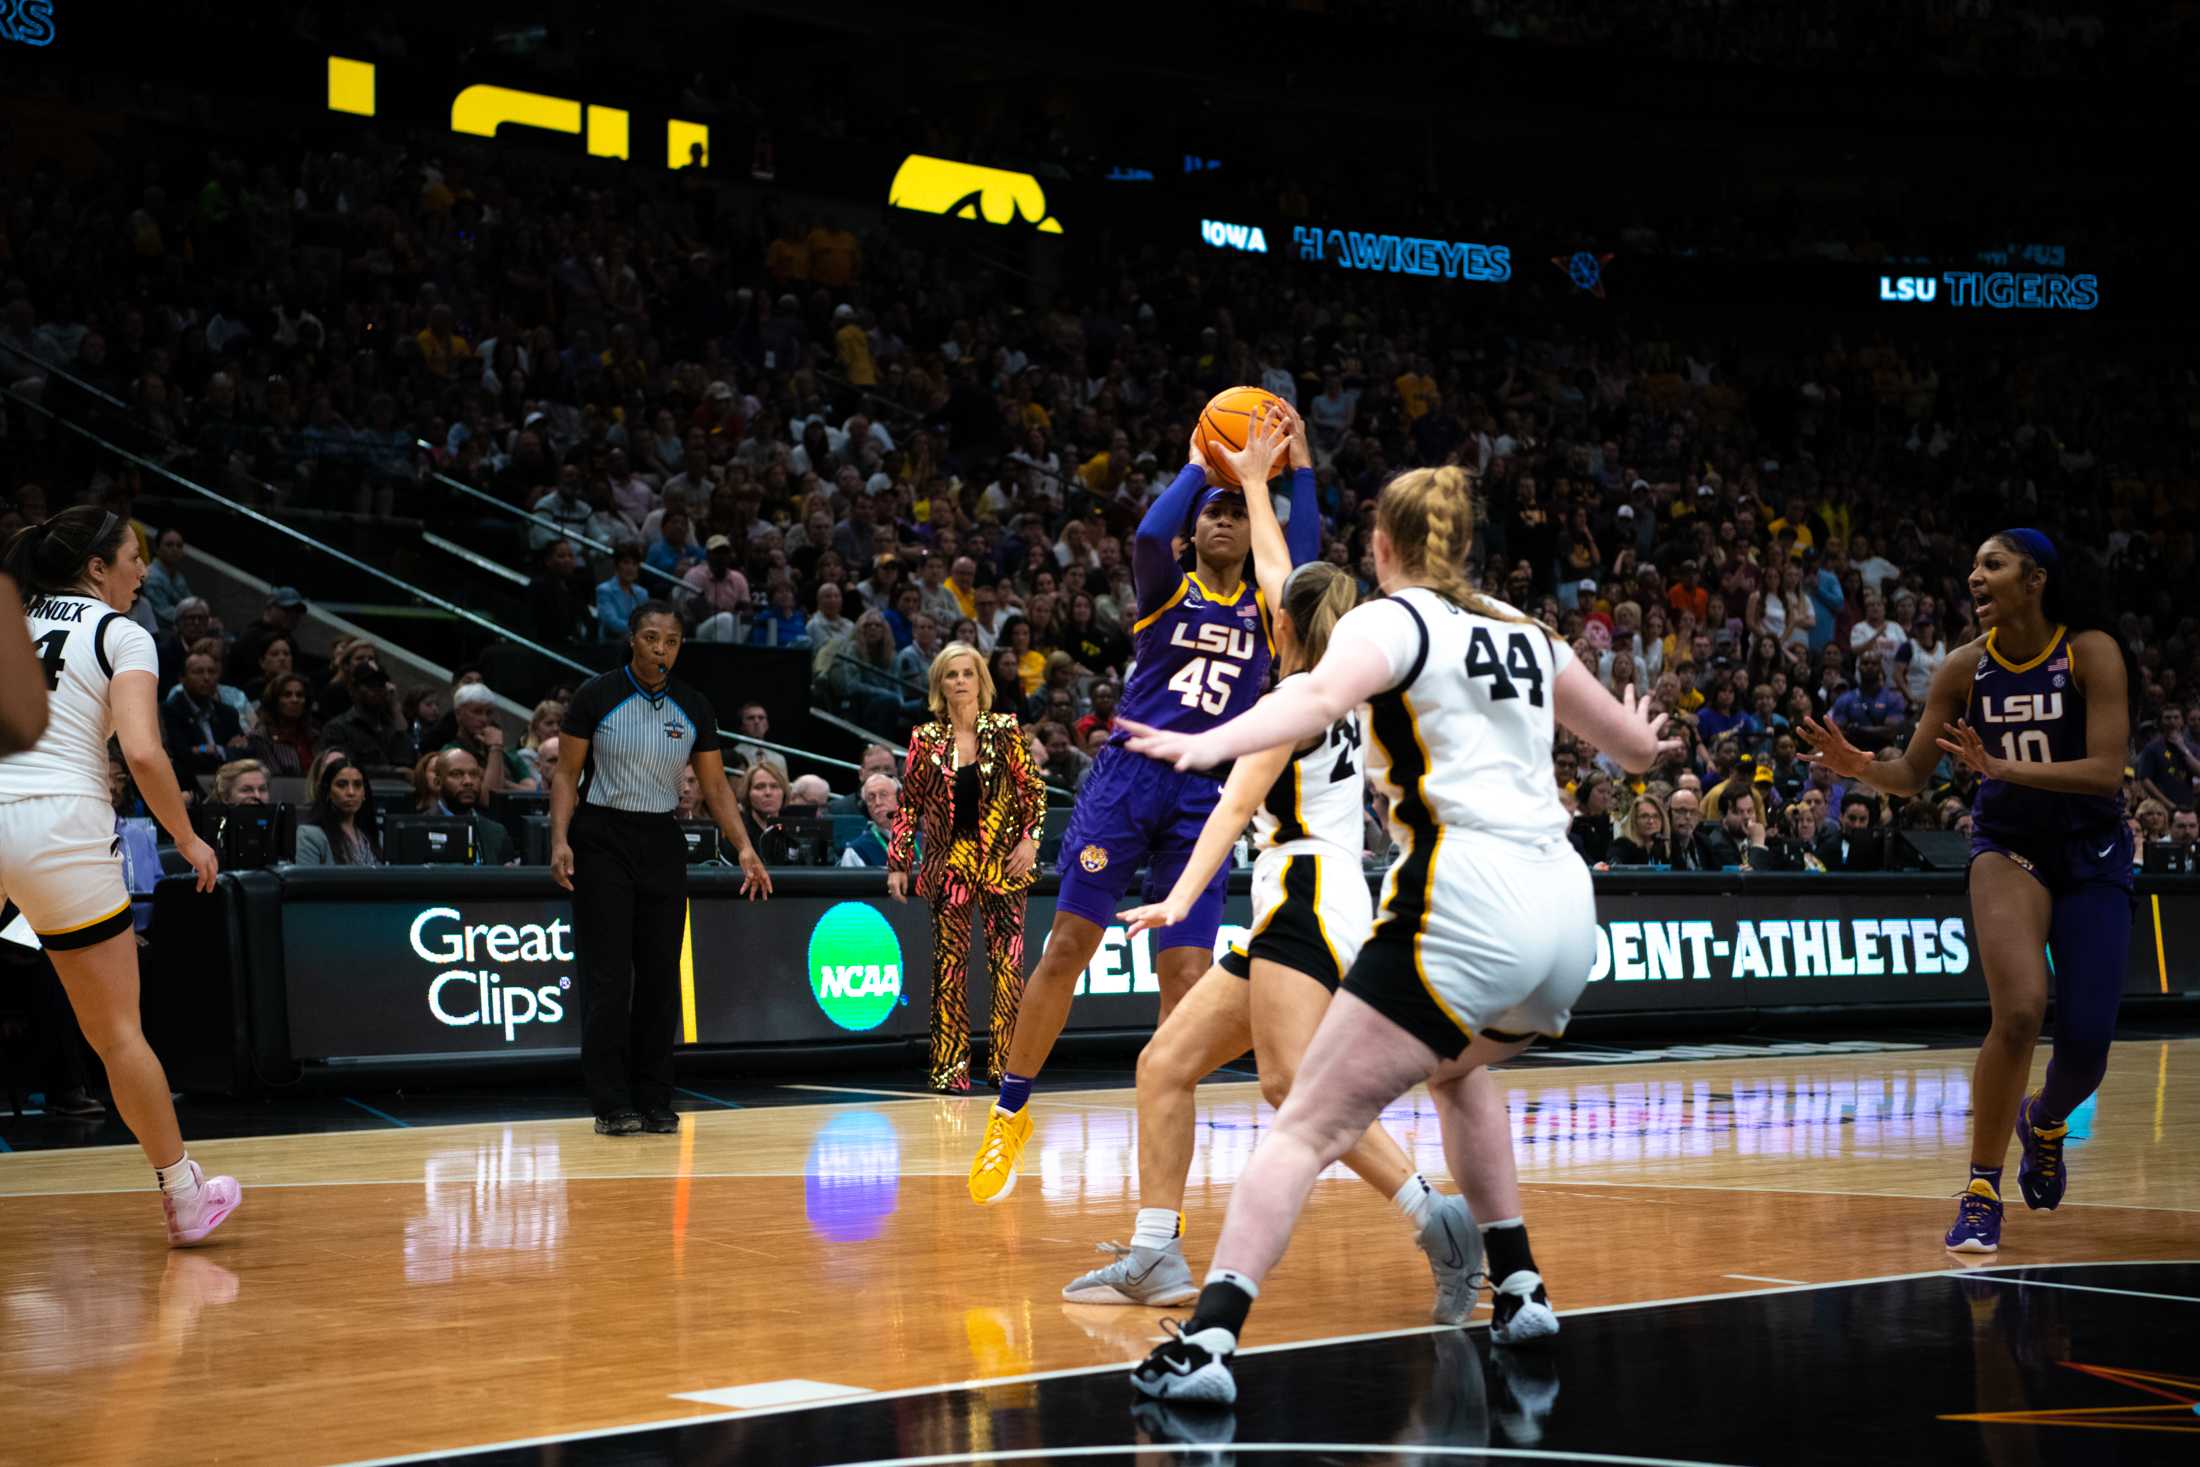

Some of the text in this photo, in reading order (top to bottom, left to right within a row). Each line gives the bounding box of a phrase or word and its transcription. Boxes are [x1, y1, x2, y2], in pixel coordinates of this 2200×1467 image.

[1201, 219, 1268, 253] IOWA
[1880, 271, 2099, 311] LSU TIGERS
[1170, 622, 1254, 660] LSU
[1168, 657, 1242, 716] 45
[1465, 627, 1543, 708] 44
[1982, 692, 2063, 723] LSU
[2001, 730, 2052, 763] 10
[410, 907, 574, 963] Great
[820, 965, 900, 998] NCAA
